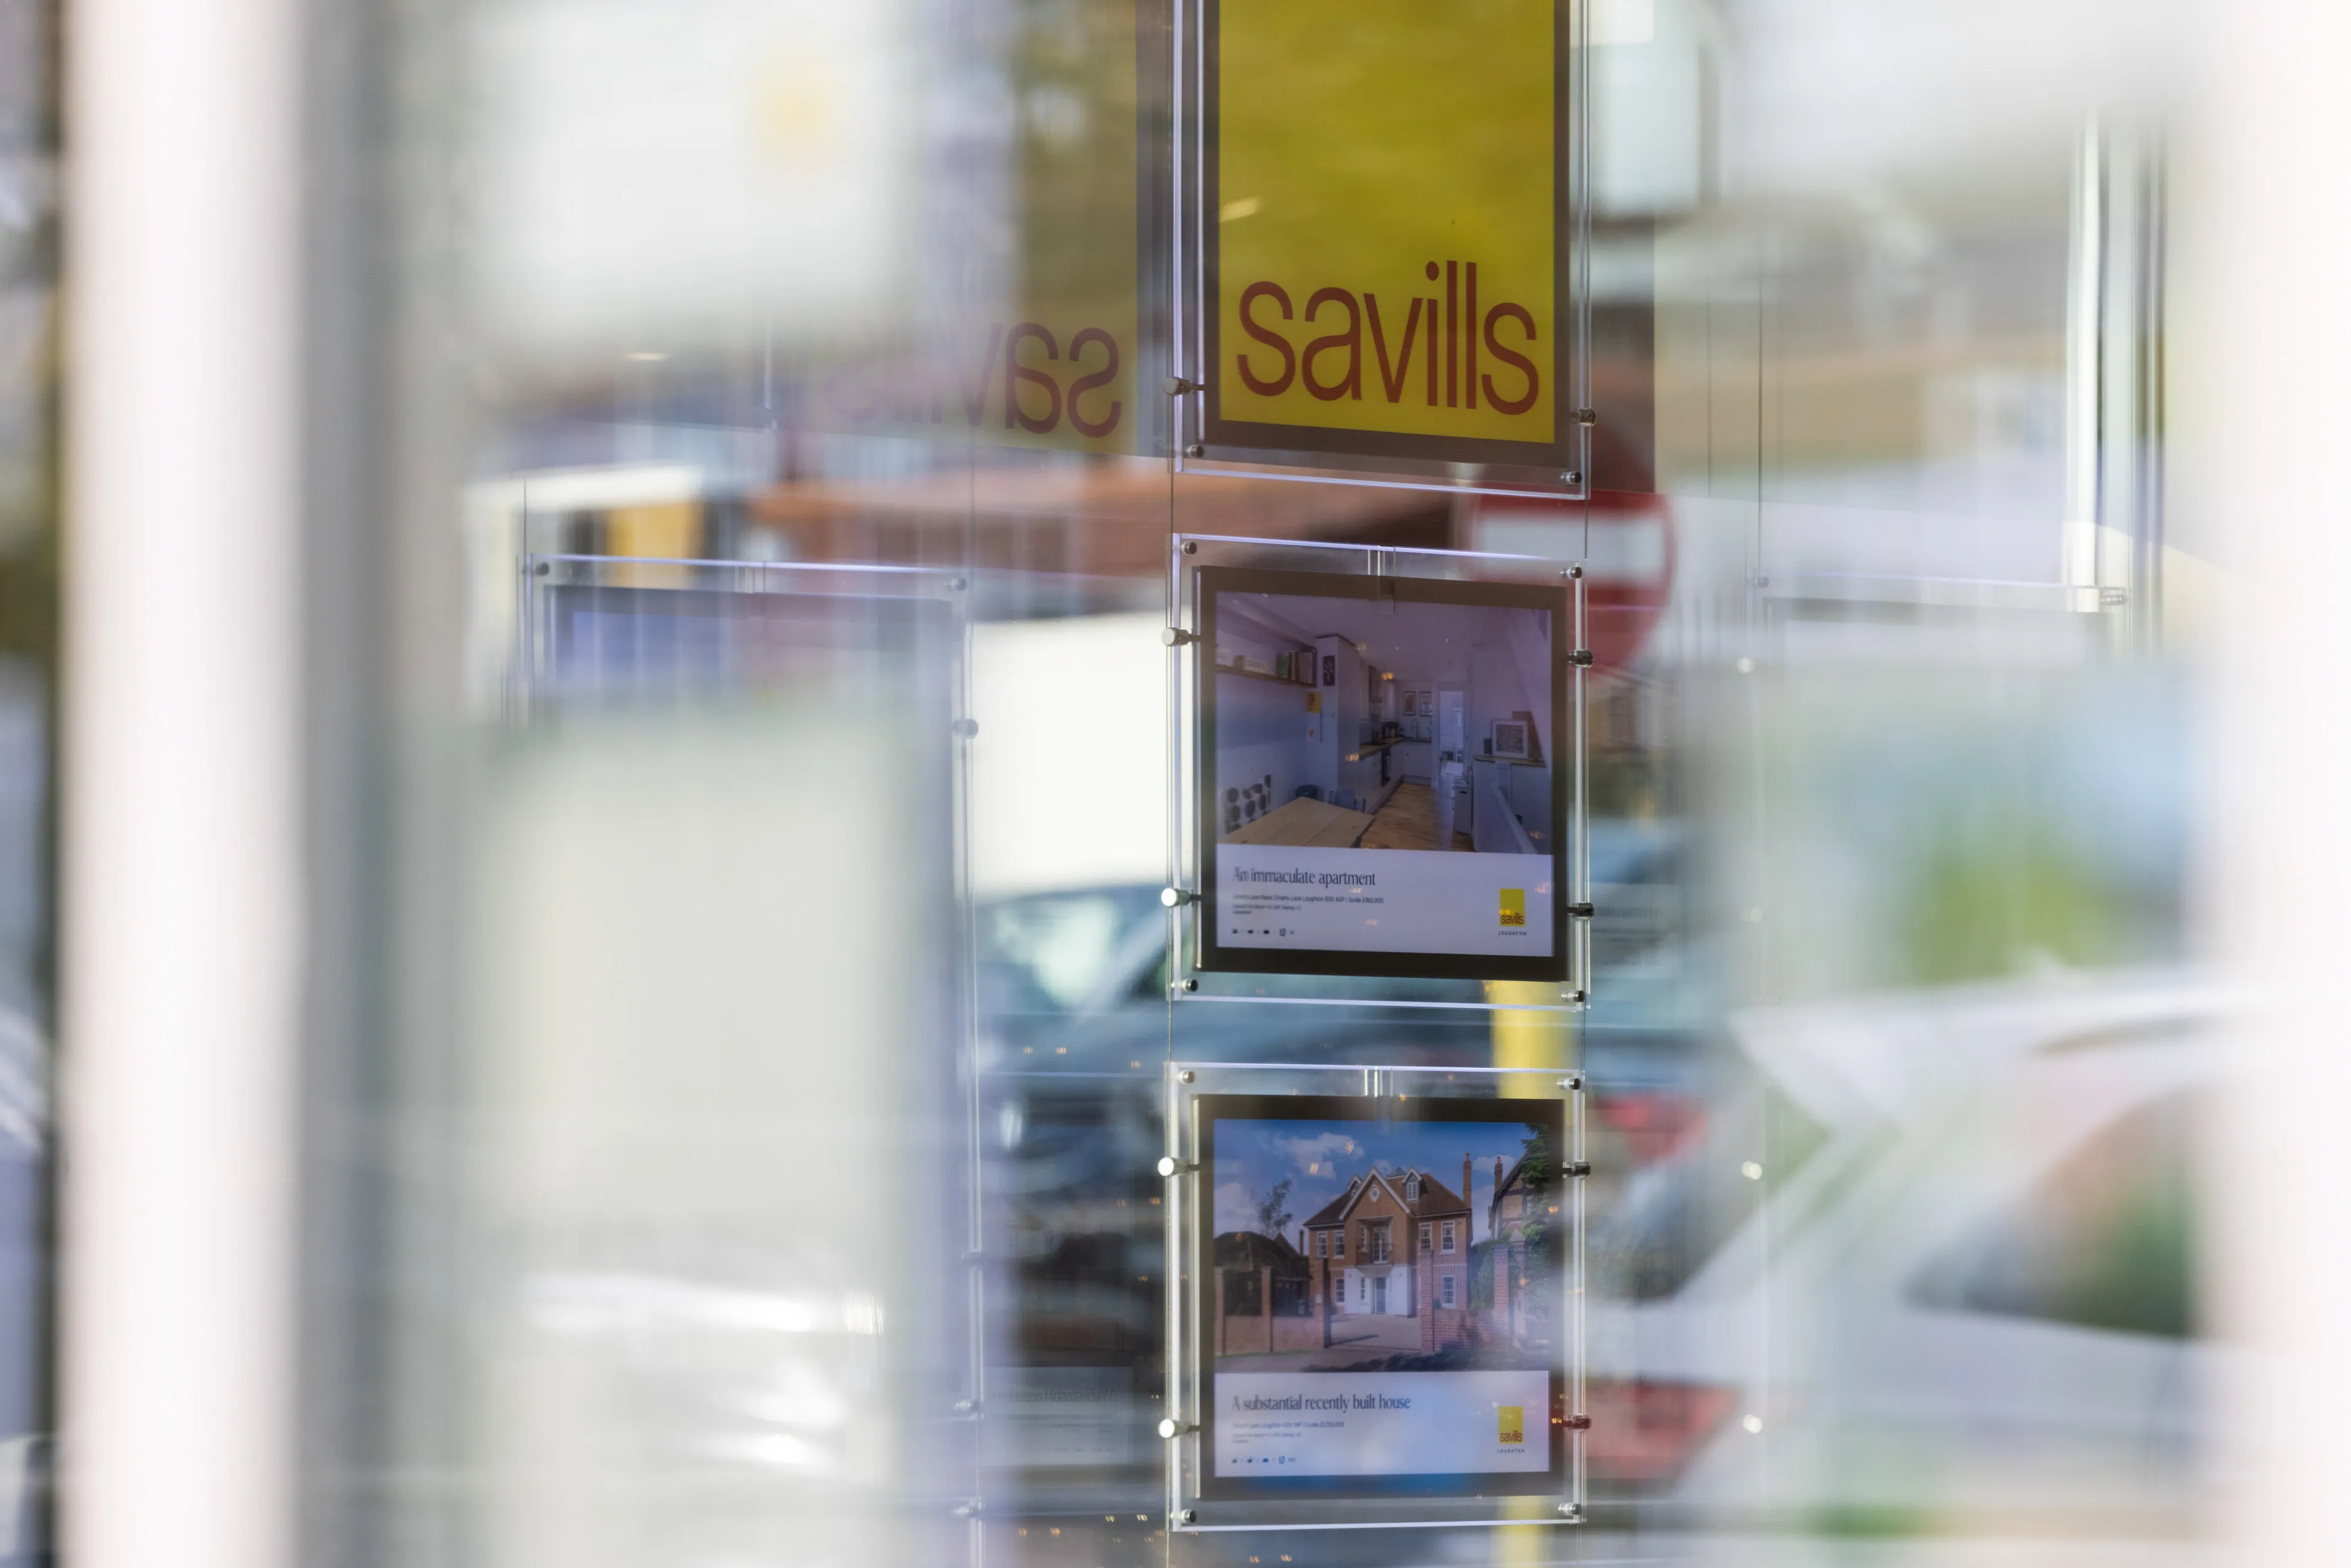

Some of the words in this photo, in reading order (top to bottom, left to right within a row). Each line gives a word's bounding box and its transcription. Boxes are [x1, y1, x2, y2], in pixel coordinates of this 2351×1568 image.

[1237, 260, 1539, 416] savills
[1251, 868, 1316, 884] immaculate
[1319, 872, 1376, 888] apartment
[1501, 912, 1523, 924] savills
[1243, 1394, 1303, 1411] substantial
[1305, 1394, 1349, 1413] recently
[1353, 1394, 1375, 1410] built
[1379, 1393, 1411, 1410] house
[1499, 1430, 1522, 1442] savills
